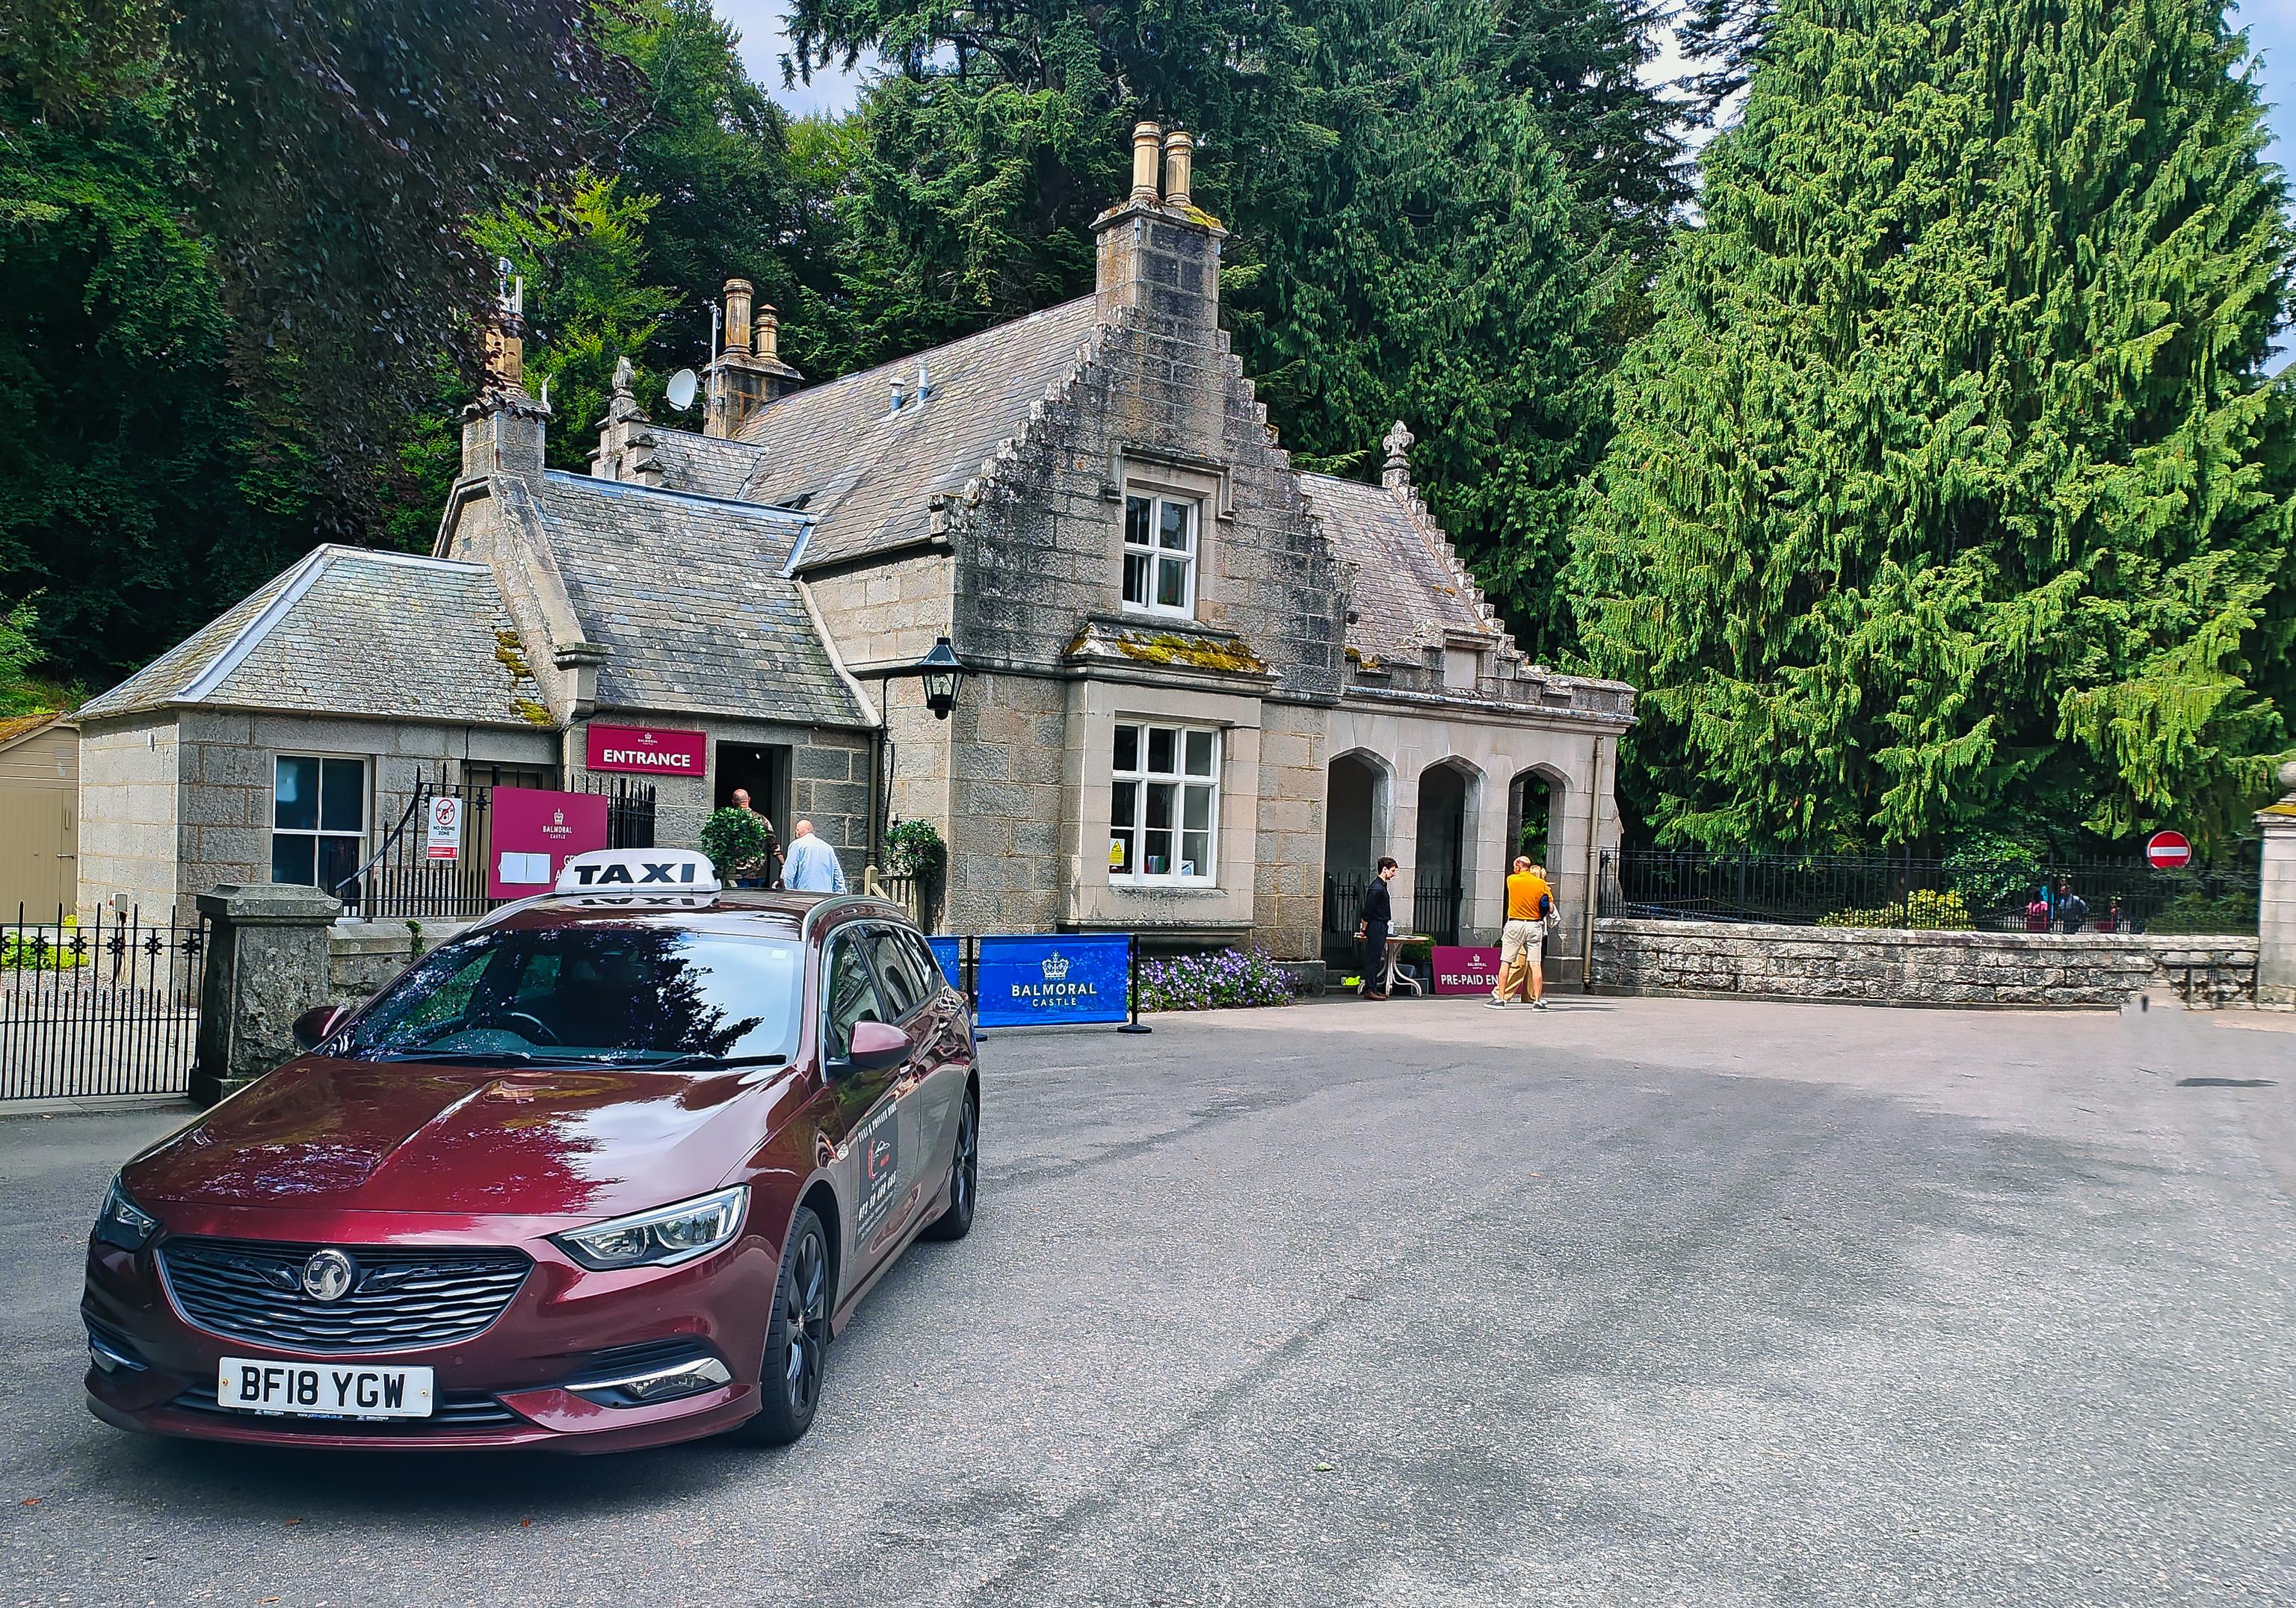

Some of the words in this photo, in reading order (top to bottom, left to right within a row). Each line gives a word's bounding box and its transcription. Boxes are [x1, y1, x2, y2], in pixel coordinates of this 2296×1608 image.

[603, 749, 691, 767] ENTRANCE
[543, 826, 573, 834] BALMORAL
[574, 863, 696, 885] TAXI
[1441, 974, 1484, 985] PRE-PAID
[1012, 983, 1097, 996] BALMORAL
[1032, 998, 1077, 1006] CASTLE
[240, 1366, 318, 1406] BF18
[332, 1372, 406, 1408] YGW
